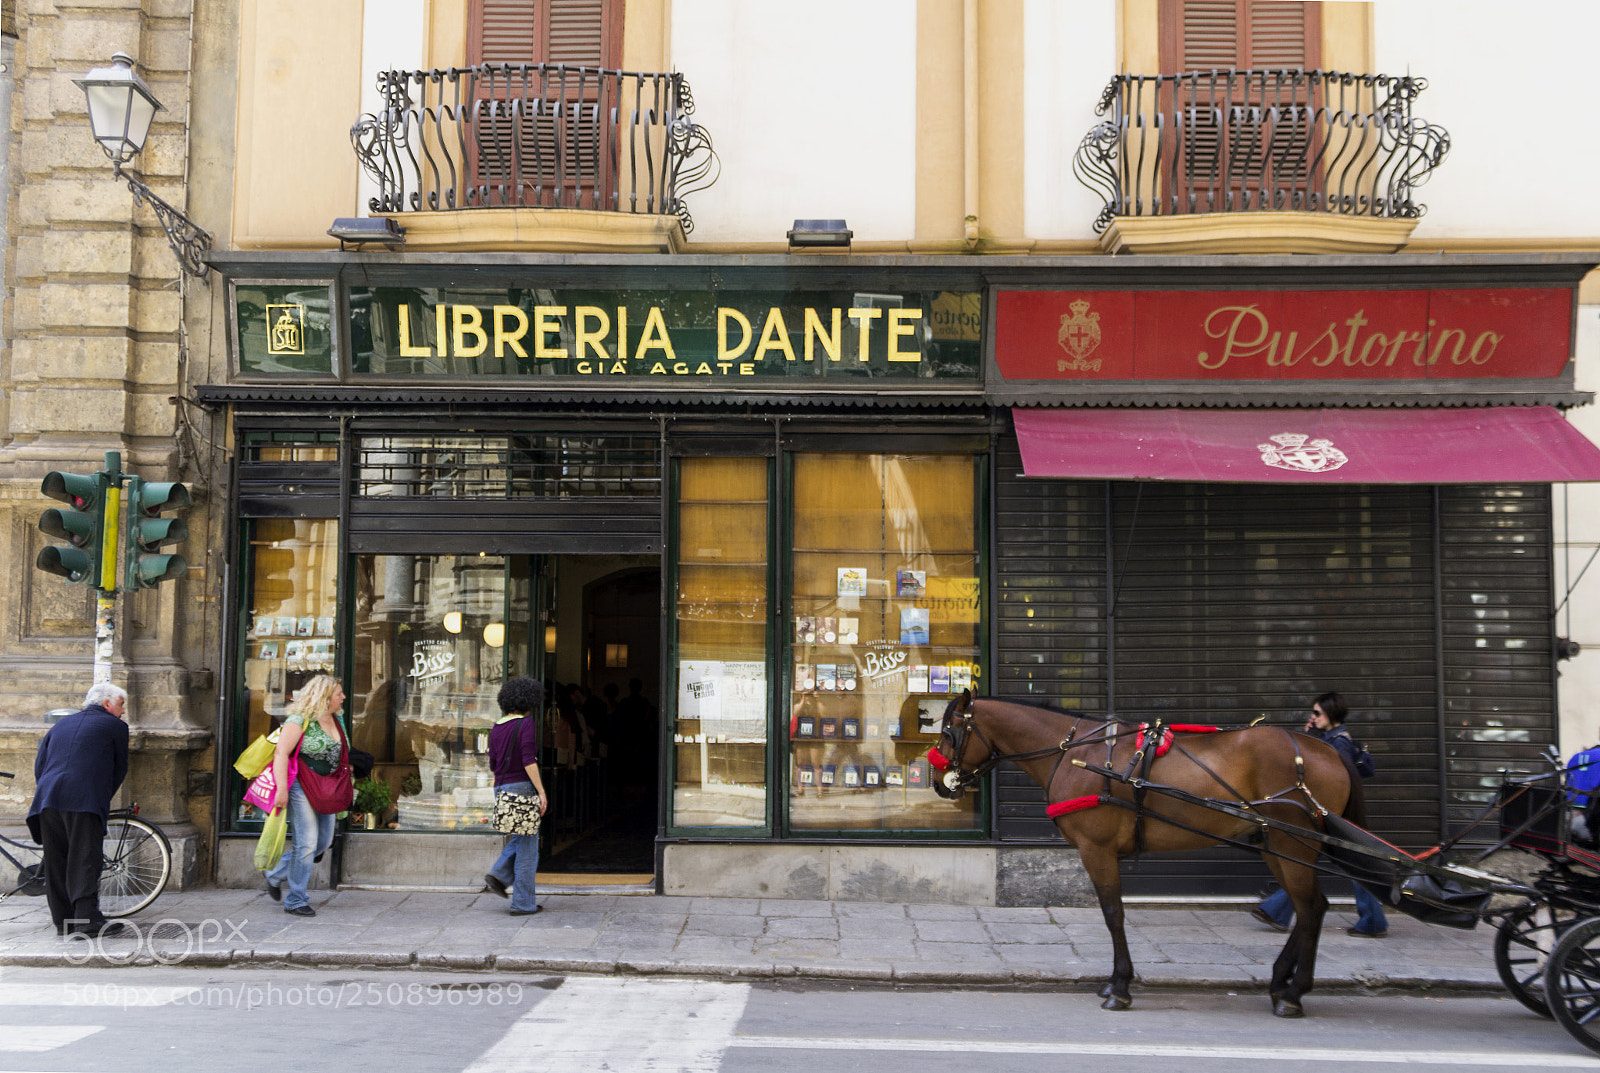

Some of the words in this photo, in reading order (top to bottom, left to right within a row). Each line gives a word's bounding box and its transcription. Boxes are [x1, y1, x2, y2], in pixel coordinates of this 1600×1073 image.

[398, 303, 676, 362] LIBRERIA
[716, 306, 923, 363] DANTE
[1197, 303, 1506, 370] Pustorino
[650, 362, 756, 376] AGATE
[407, 651, 456, 678] Bisso
[859, 650, 908, 678] Bisso
